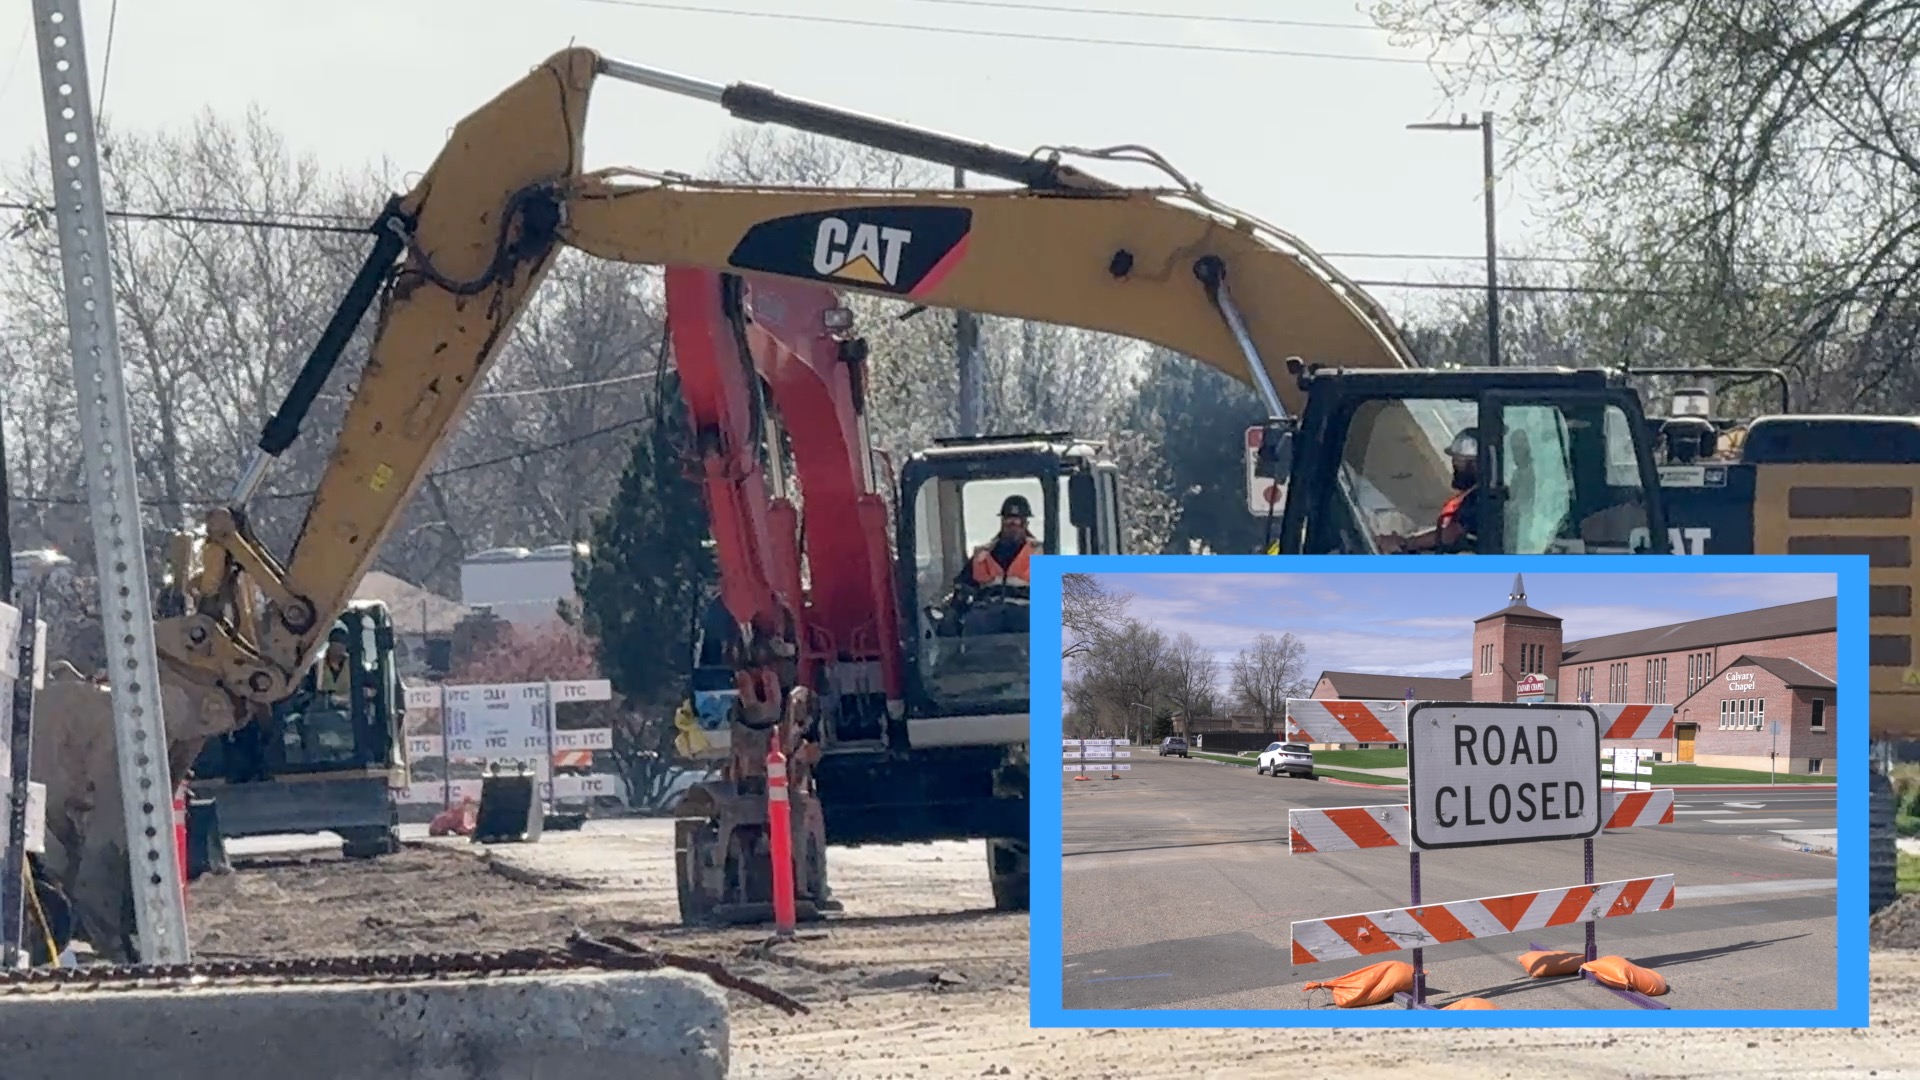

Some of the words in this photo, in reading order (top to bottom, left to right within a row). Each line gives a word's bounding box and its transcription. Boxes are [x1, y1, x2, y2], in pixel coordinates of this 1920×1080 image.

[813, 216, 912, 286] CAT
[1725, 672, 1755, 682] Calvary
[563, 685, 587, 697] ITC
[1728, 681, 1755, 693] Chapel
[410, 692, 431, 704] ITC
[448, 691, 470, 701] ITC
[522, 687, 544, 698] ITC
[450, 739, 472, 750] ITC
[524, 736, 545, 748] ITC
[555, 735, 577, 746] ITC
[583, 733, 605, 745] ITC
[1454, 724, 1558, 766] ROAD
[409, 740, 431, 752] ITC
[581, 780, 603, 791] ITC
[1435, 781, 1585, 828] CLOSED
